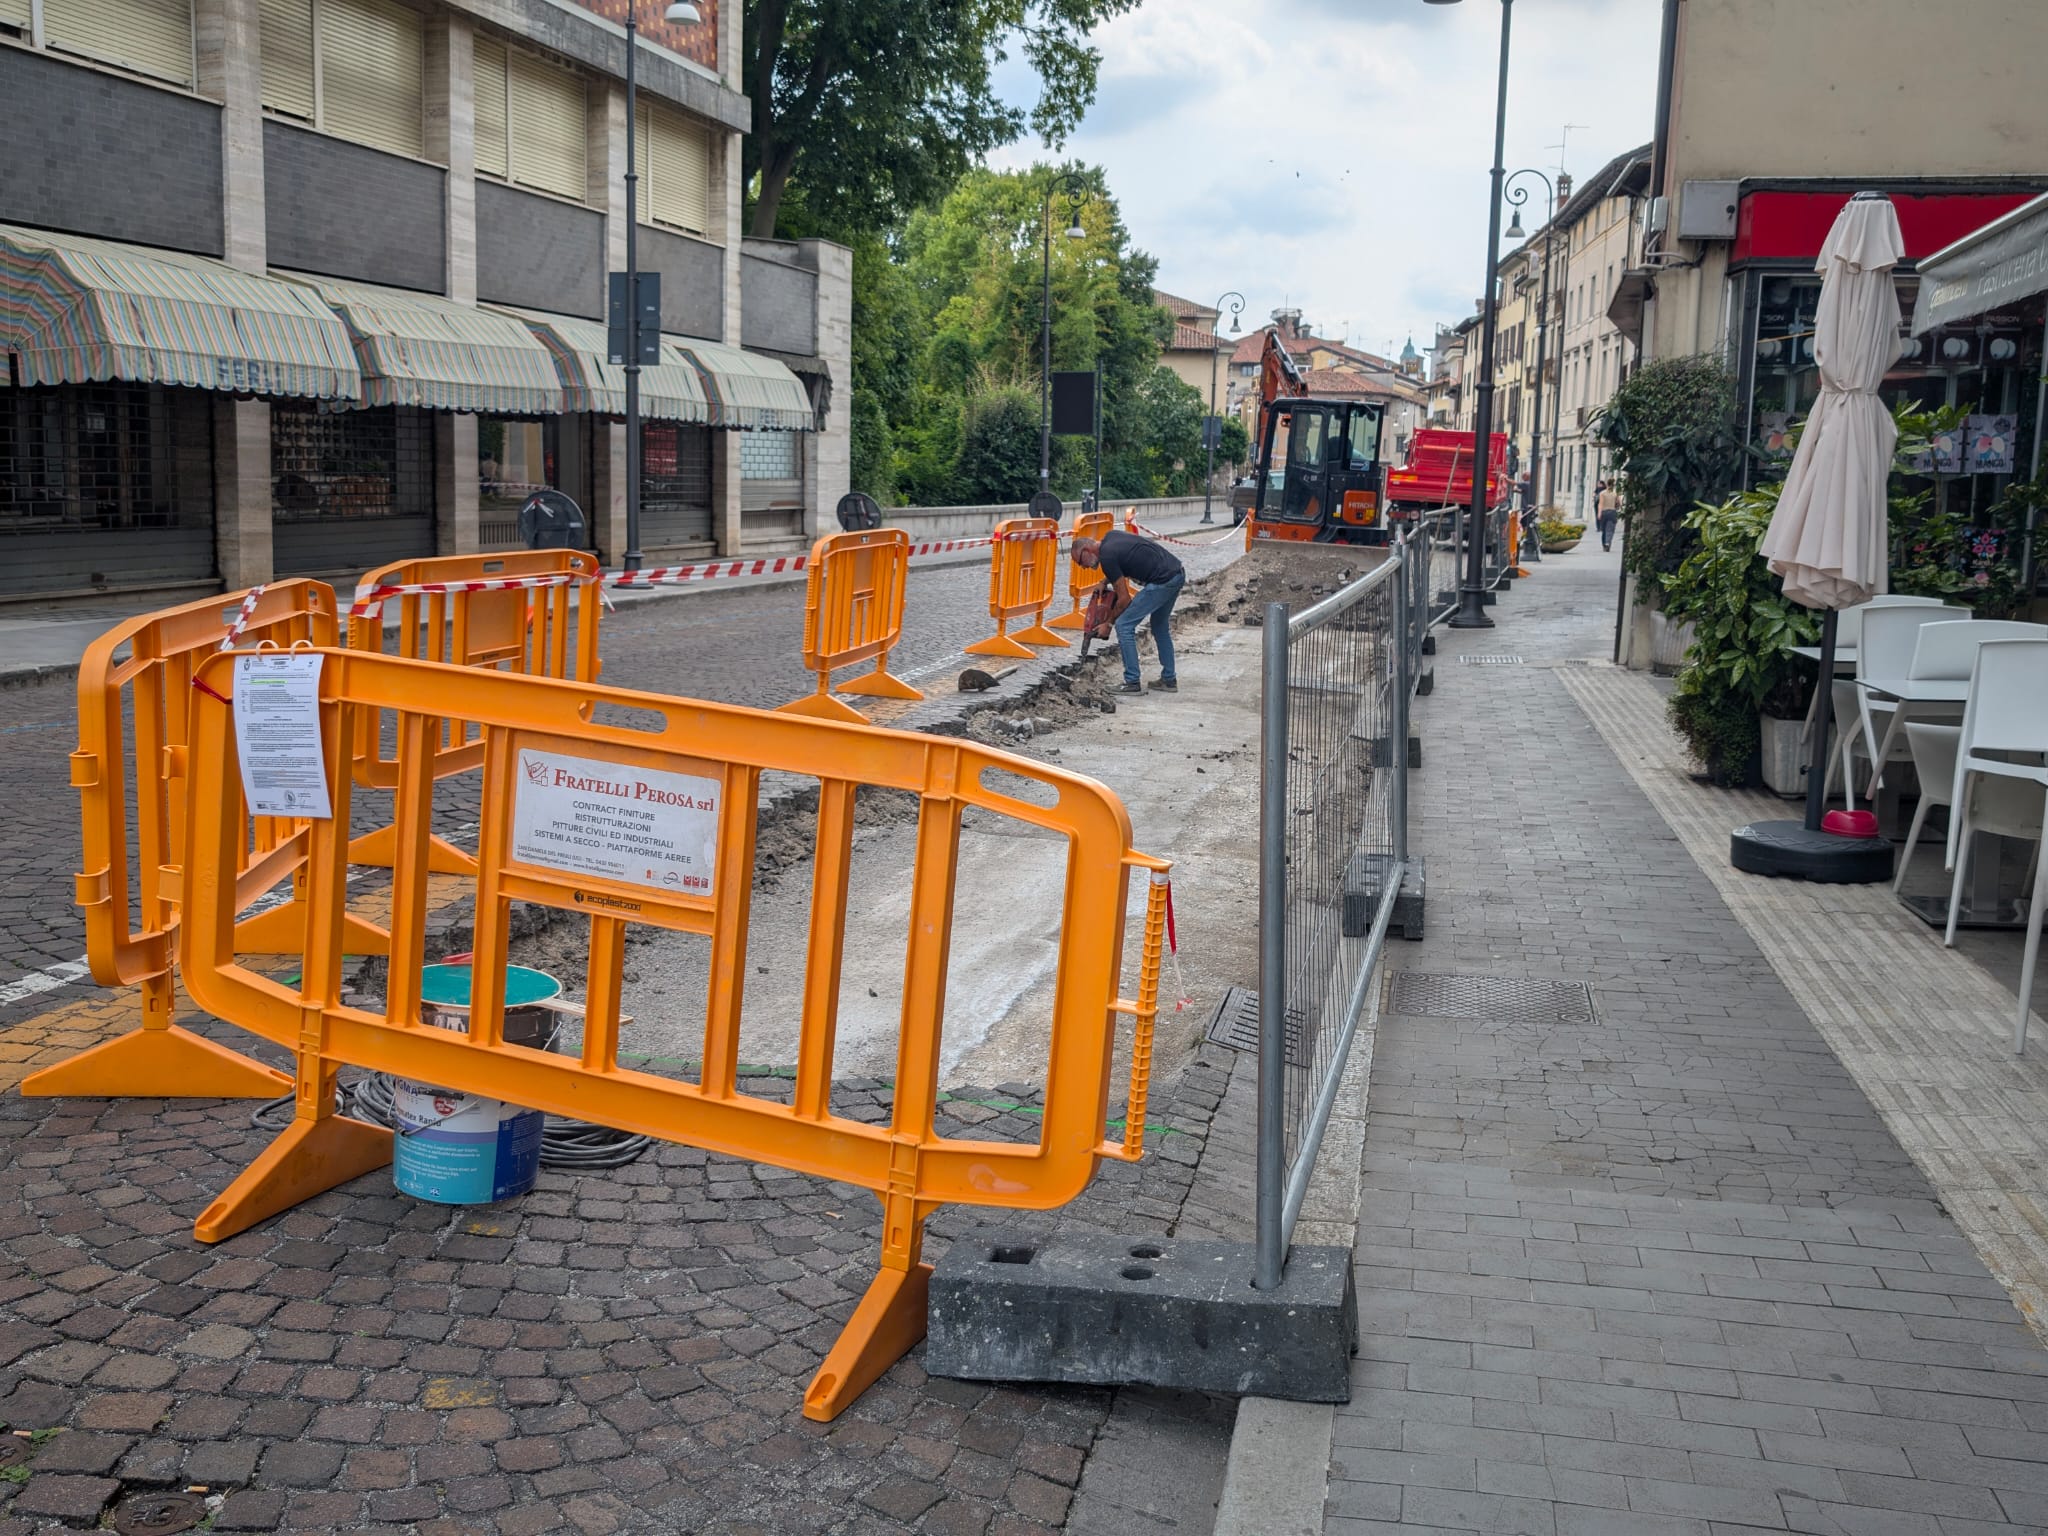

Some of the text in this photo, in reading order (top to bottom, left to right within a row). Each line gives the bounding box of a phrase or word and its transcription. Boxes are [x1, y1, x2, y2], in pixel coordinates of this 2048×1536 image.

[553, 768, 714, 812] FRATELLI PEROSA srl
[573, 800, 655, 821] CONTRACT FINITURE
[575, 813, 651, 833] RISTRUTTURAZIONI
[534, 829, 564, 841] SISTEMI
[565, 835, 572, 843] A
[573, 836, 600, 848] SECCO
[607, 842, 663, 859] PIATTAFORME
[664, 853, 692, 864] AEREE
[552, 820, 673, 848] PITTURE CIVILI ED INDUSTRIALI
